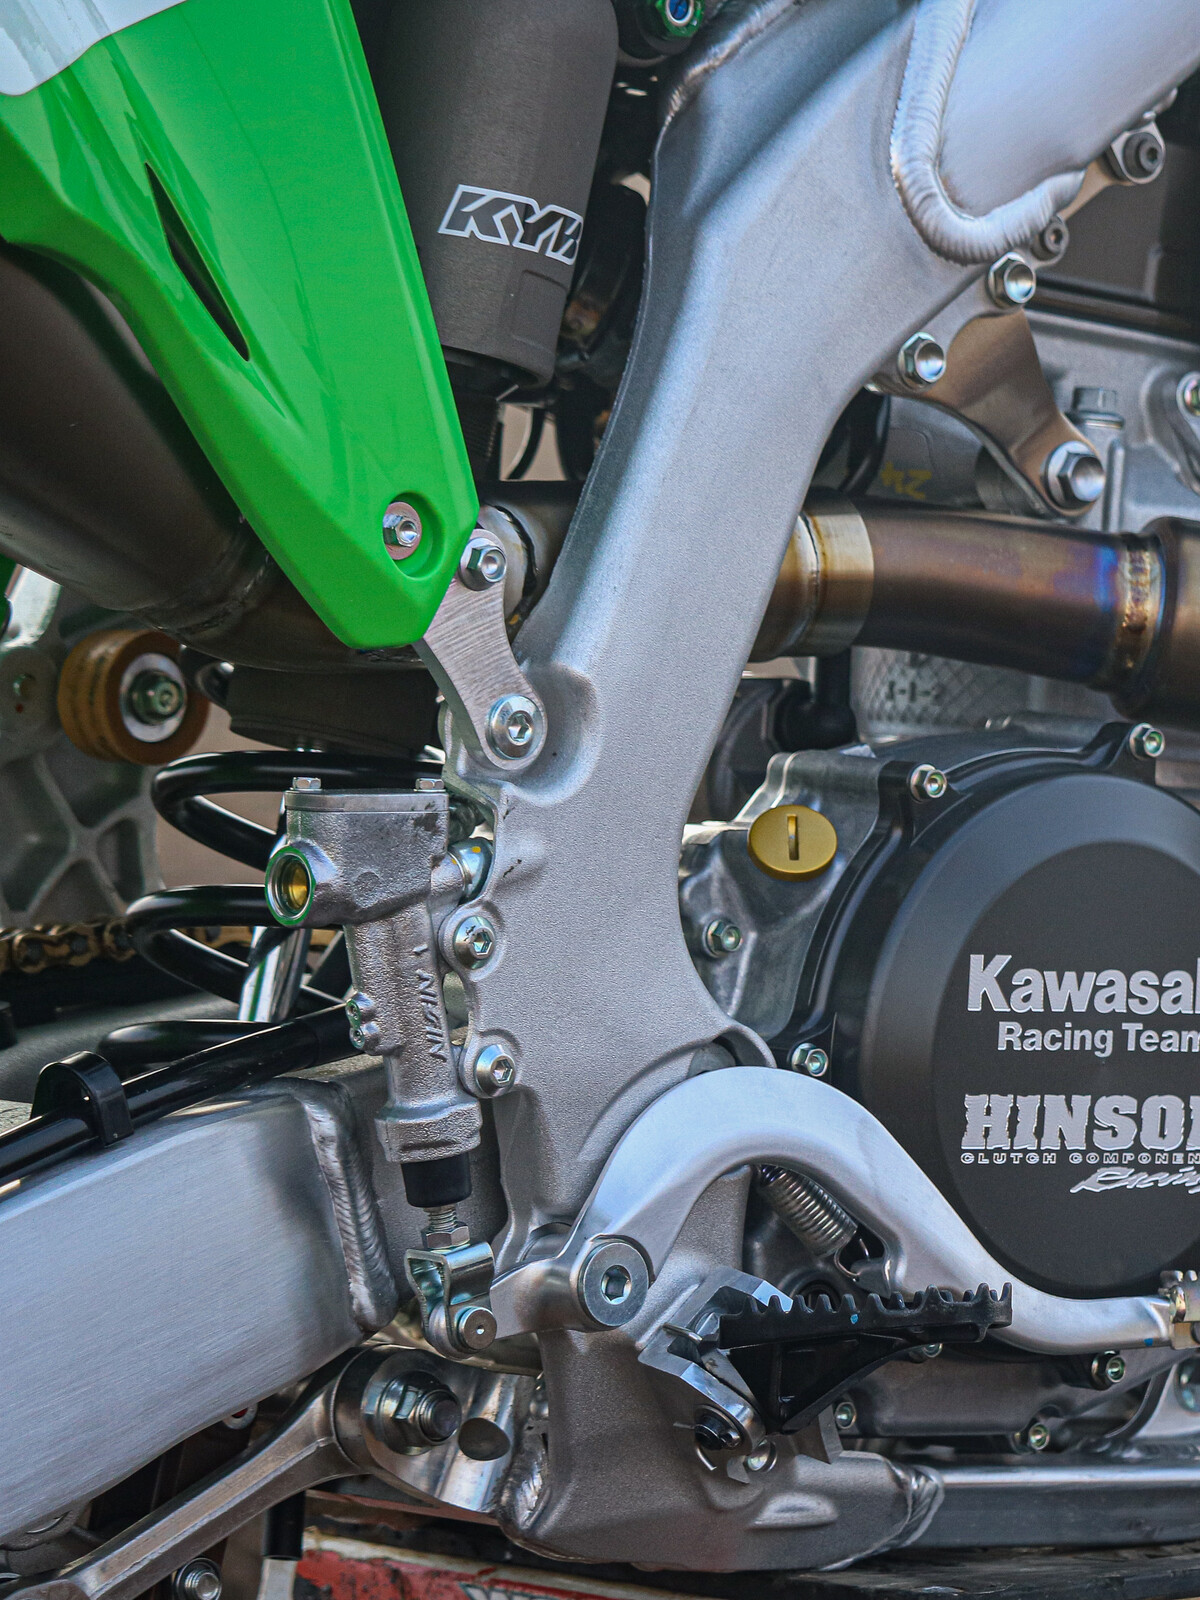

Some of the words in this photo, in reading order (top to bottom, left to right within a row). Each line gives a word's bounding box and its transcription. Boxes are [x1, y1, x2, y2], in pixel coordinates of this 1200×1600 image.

[438, 184, 584, 266] KYB
[997, 1021, 1114, 1058] Racing
[960, 1152, 1057, 1165] CLUTCH
